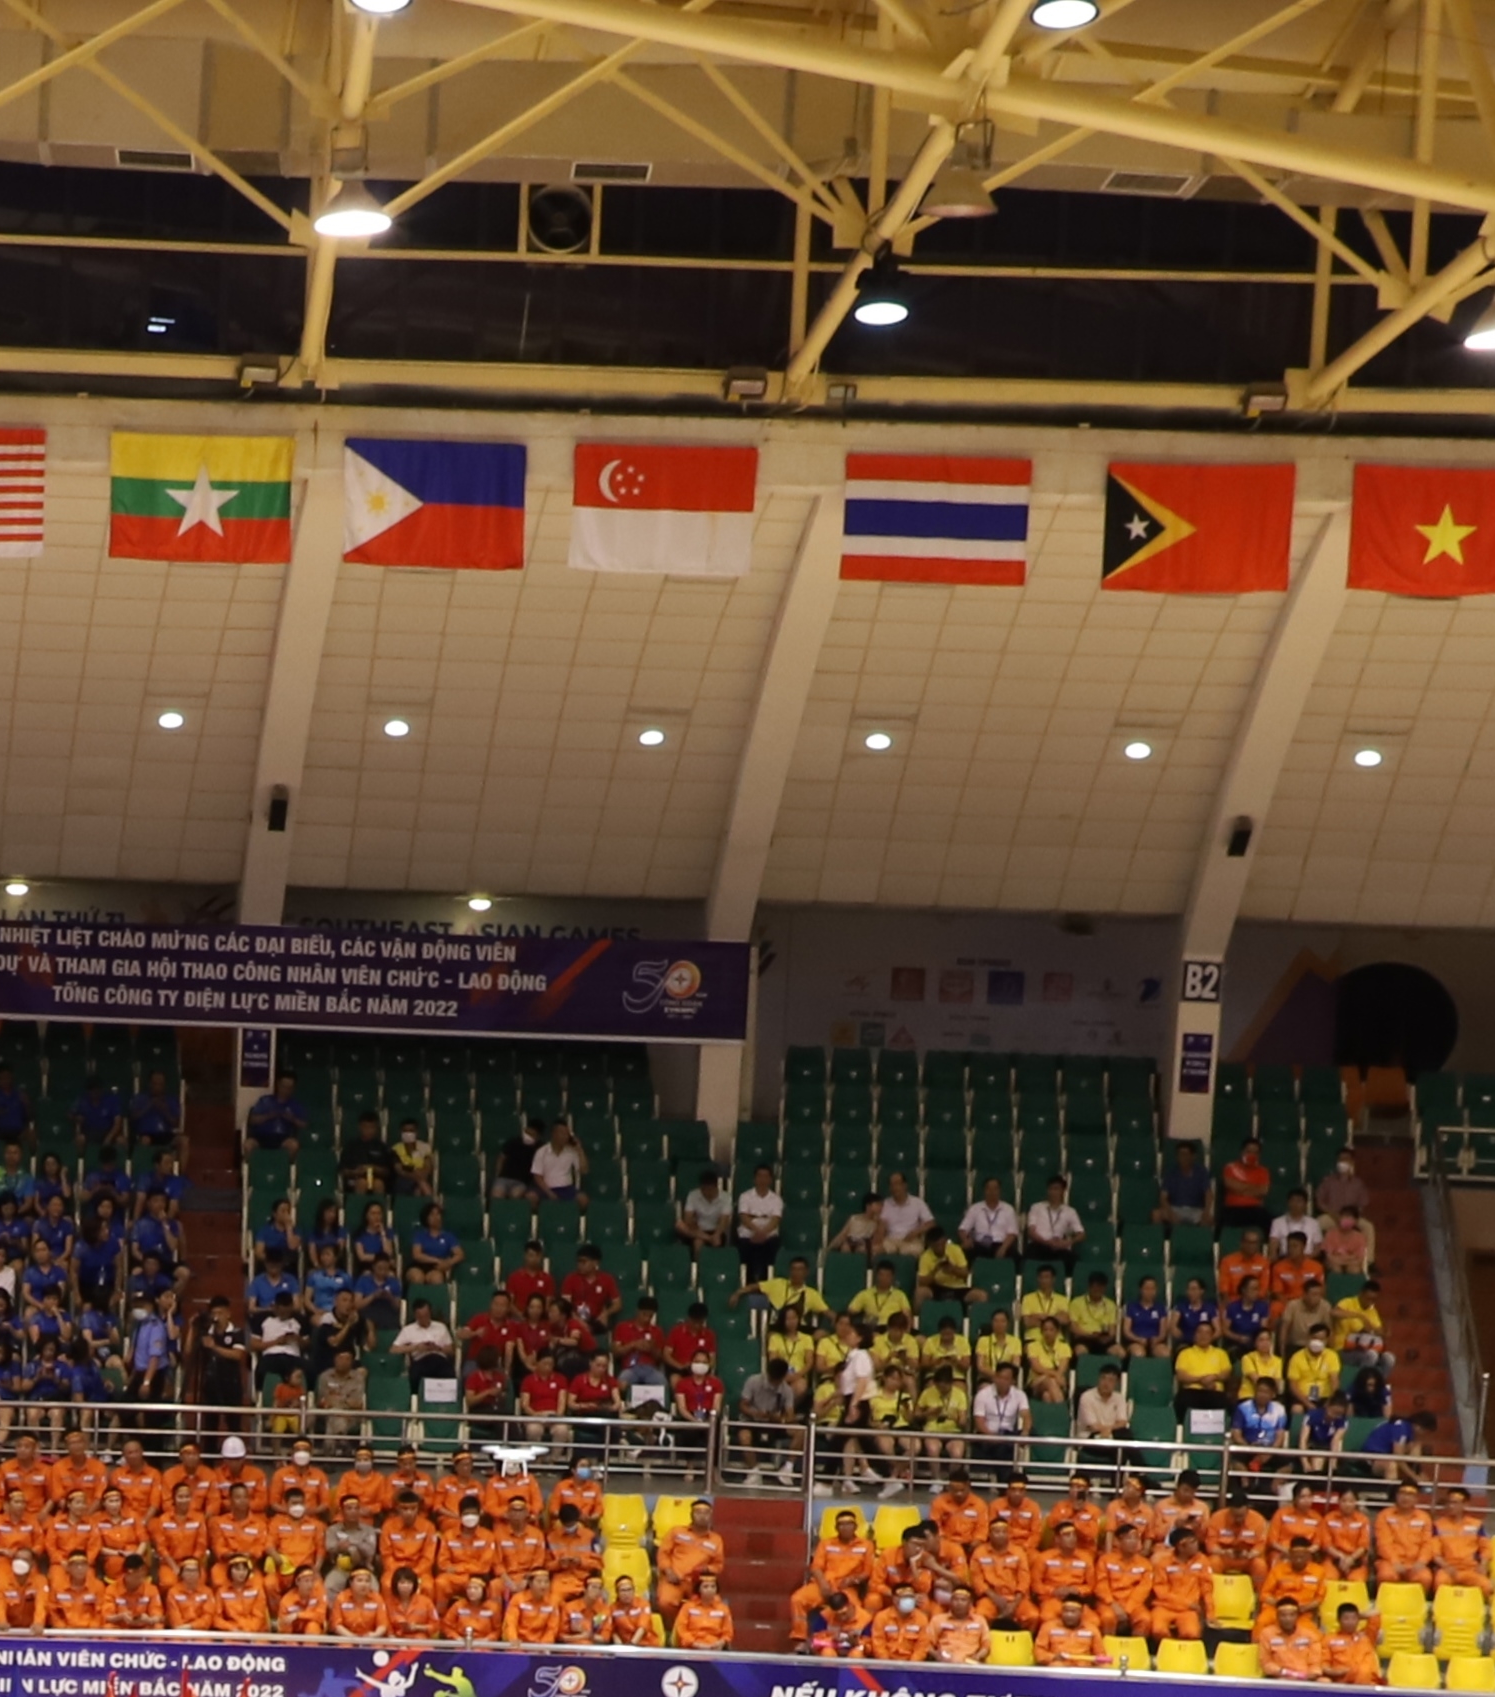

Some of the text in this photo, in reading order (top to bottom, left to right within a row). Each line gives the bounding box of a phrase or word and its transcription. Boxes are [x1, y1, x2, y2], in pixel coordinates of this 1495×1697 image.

[0, 926, 52, 947] NHIỆT
[56, 927, 91, 948] LIỆT
[98, 927, 146, 949] CHÀO
[151, 930, 209, 951] MỪNG
[214, 931, 250, 953] CÁC
[255, 936, 285, 958] ĐẠI
[340, 936, 376, 958] CÁC
[380, 940, 416, 962] VẬN
[421, 941, 471, 964] ĐỘNG
[476, 942, 516, 963] VIÊN
[28, 953, 52, 974] VÀ
[55, 956, 106, 976] THAM
[112, 957, 142, 978] GIA
[147, 956, 177, 982] HỘI
[182, 961, 228, 981] THAO
[233, 960, 281, 983] CÔNG
[286, 965, 336, 985] NHÂN
[342, 965, 381, 986] VIÊN
[386, 966, 440, 988] CHỨC
[458, 971, 493, 990] LAO
[497, 968, 547, 995] ĐỘNG
[1184, 964, 1218, 1000] B2
[53, 983, 458, 1018] TỔNG CÔNG TY ĐIỆN LỰC MIỀN BẮC NĂM 2022
